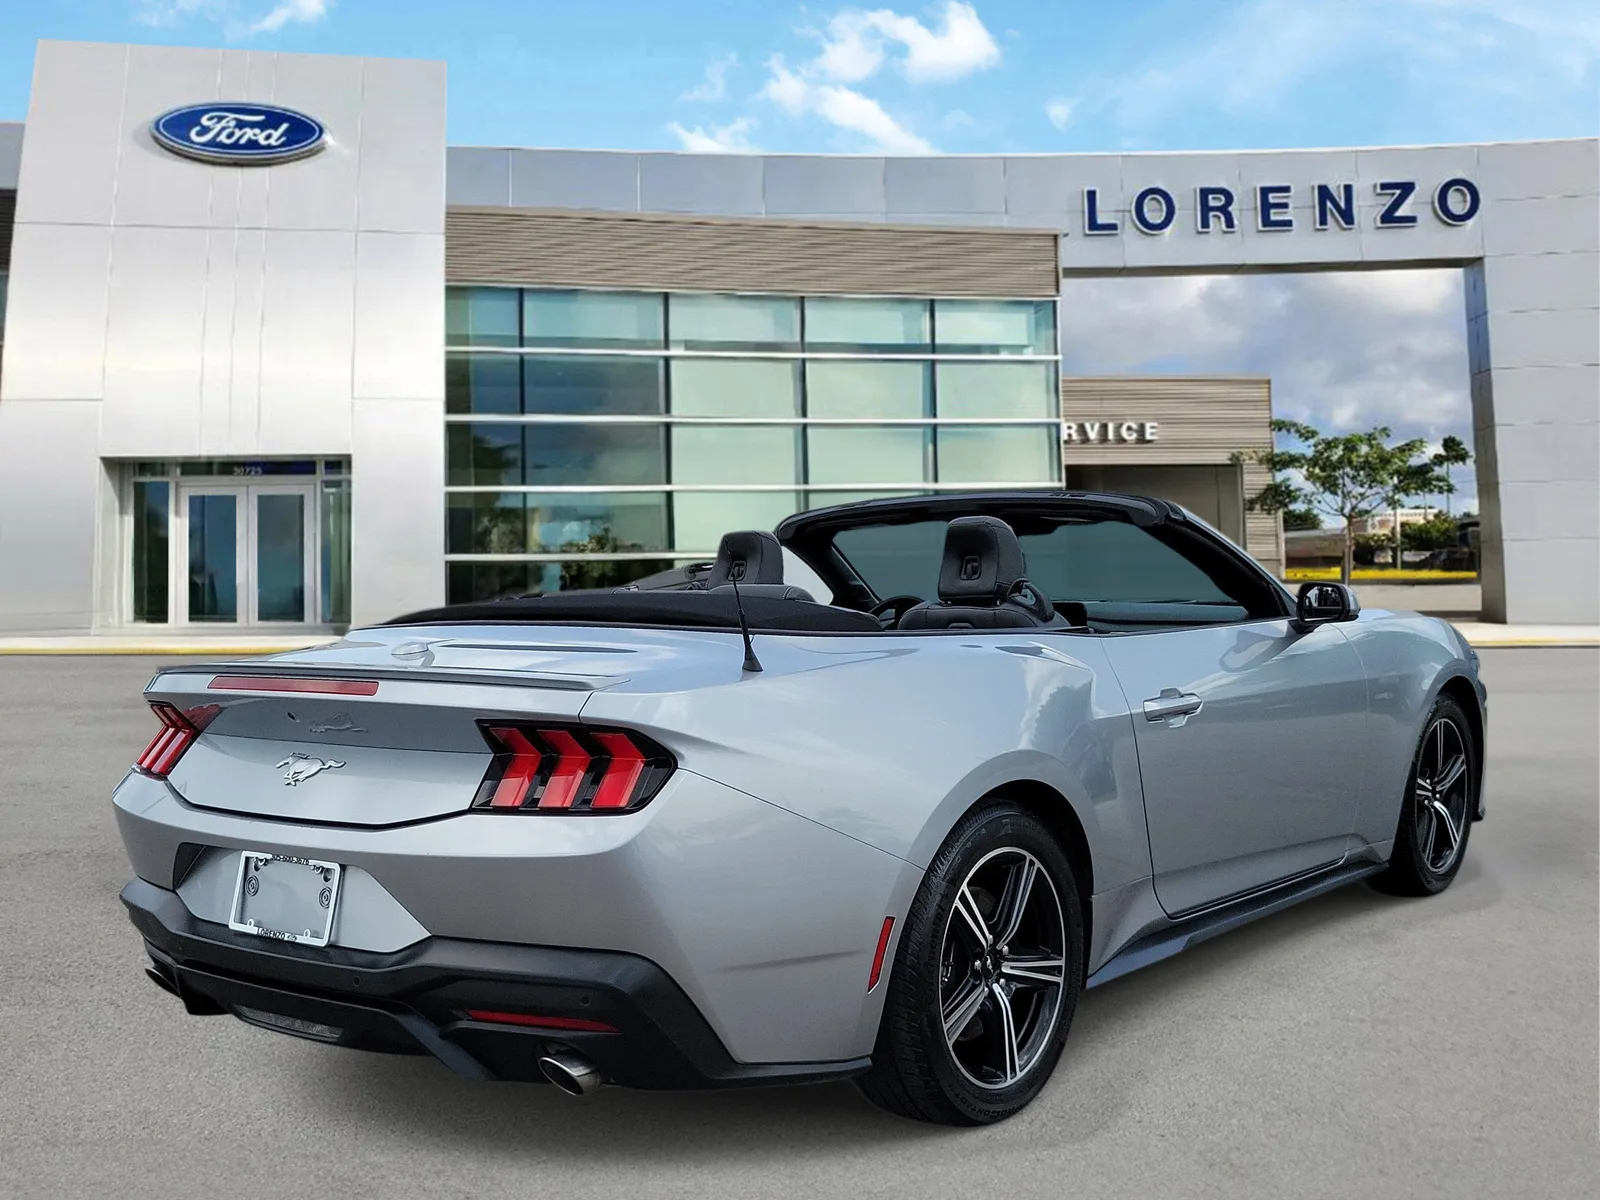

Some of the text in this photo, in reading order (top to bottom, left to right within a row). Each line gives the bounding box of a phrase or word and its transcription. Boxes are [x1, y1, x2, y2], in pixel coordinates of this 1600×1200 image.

[188, 111, 290, 146] Ford
[1083, 177, 1482, 236] LORENZO
[1063, 421, 1159, 441] RVICE
[256, 927, 286, 941] LORENZO
